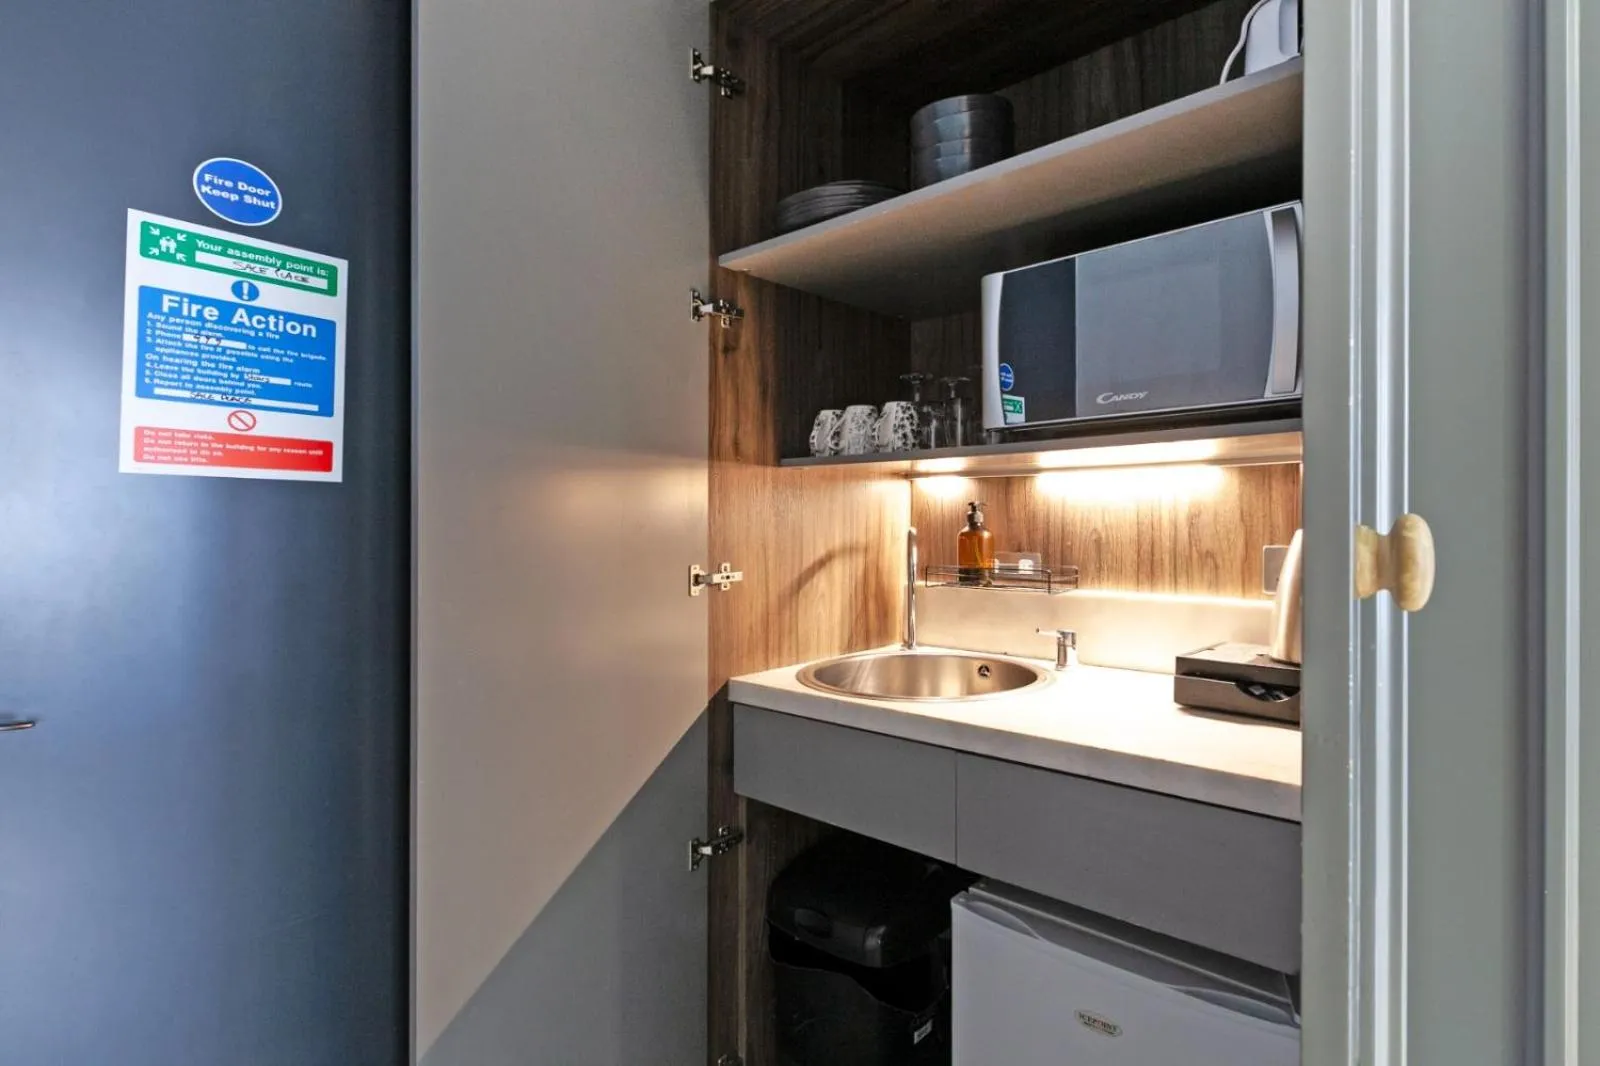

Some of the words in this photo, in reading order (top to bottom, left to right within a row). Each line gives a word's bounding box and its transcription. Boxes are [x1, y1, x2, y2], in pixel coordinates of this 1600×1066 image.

[204, 173, 234, 188] Fire
[237, 181, 271, 196] Door
[200, 184, 239, 202] Keep
[243, 194, 276, 209] Shut
[195, 239, 222, 252] Your
[227, 248, 282, 266] assembly
[286, 260, 314, 273] point
[317, 267, 328, 276] is:
[147, 312, 166, 322] Any
[168, 317, 202, 326] person
[205, 322, 255, 336] discovering
[162, 294, 220, 321] Fire
[231, 308, 316, 338] Action
[156, 330, 181, 338] Phone
[163, 355, 198, 367] hearing
[218, 362, 233, 370] fire
[236, 365, 260, 373] alarm
[1096, 391, 1149, 404] CANDY
